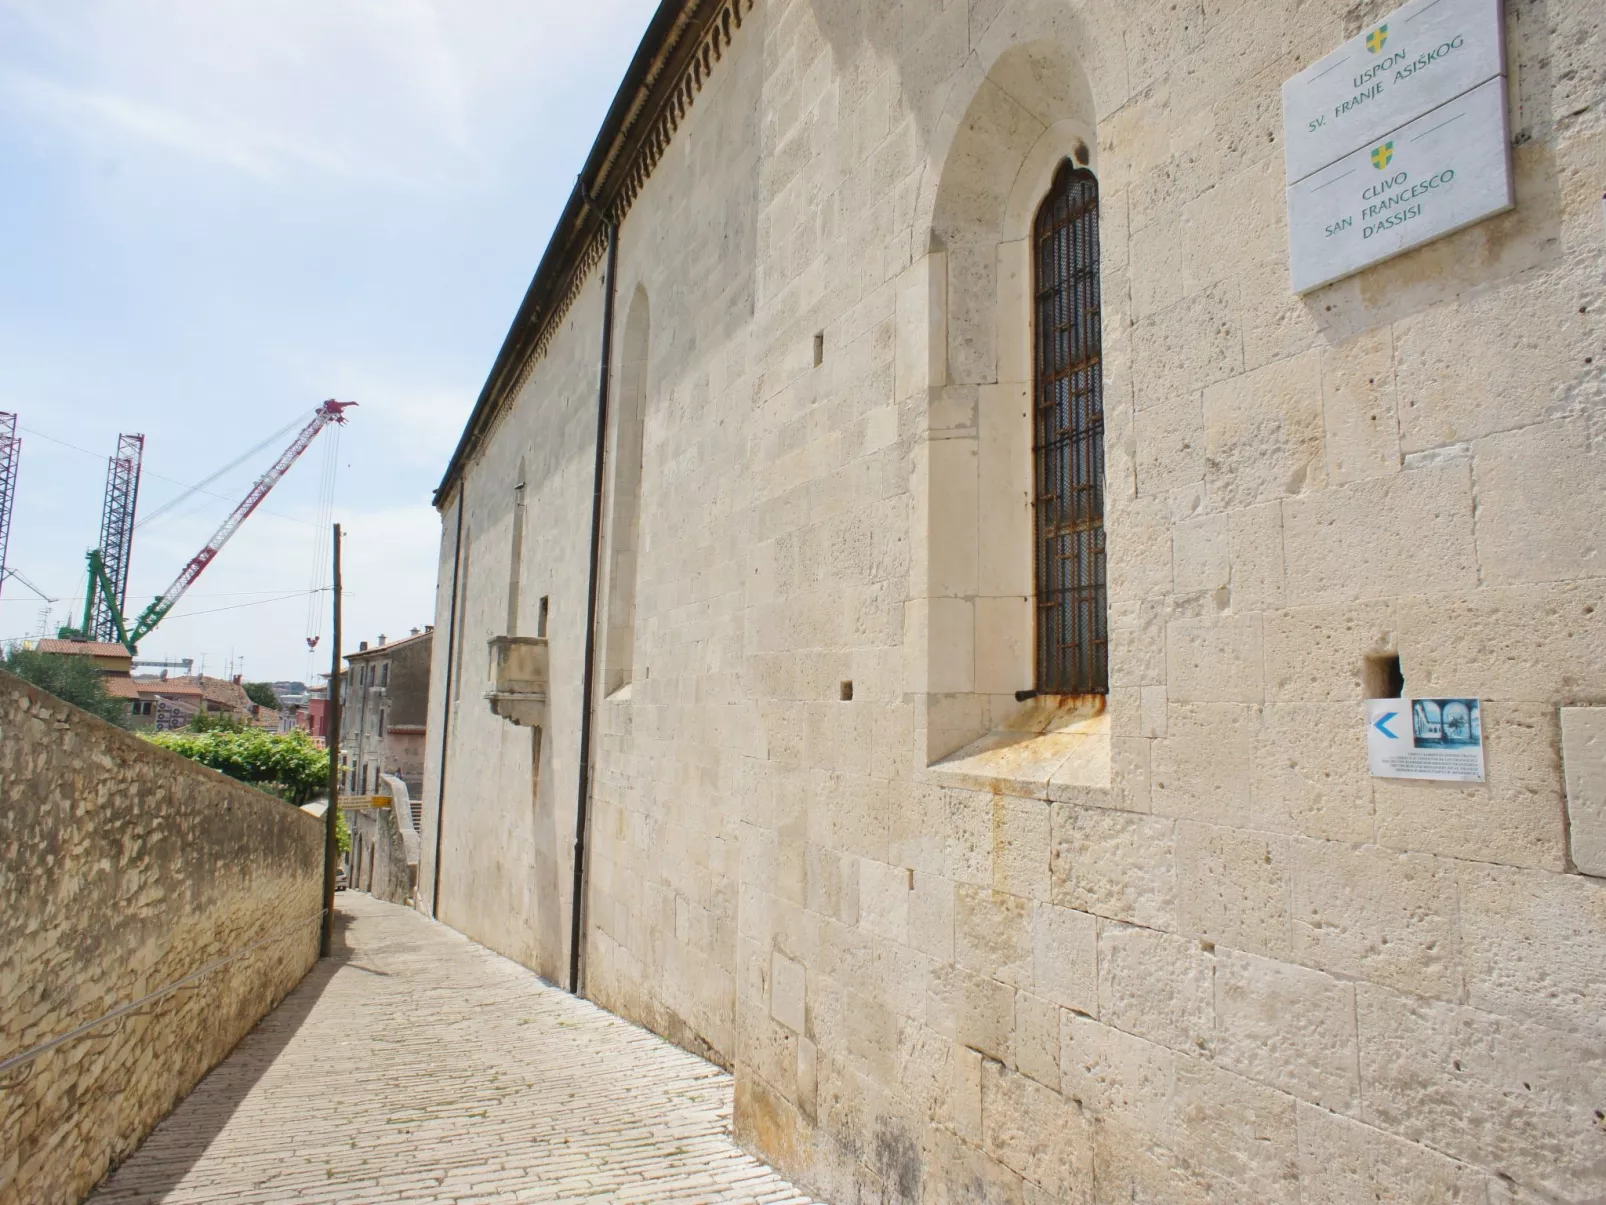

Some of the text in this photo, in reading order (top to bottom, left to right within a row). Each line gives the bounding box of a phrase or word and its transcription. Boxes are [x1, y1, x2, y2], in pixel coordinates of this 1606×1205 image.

[1308, 34, 1464, 133] SV. FRANJE ASIŠKOG
[1353, 48, 1406, 88] USPON
[1324, 169, 1455, 238] SAN FRANCESCO
[1362, 171, 1407, 201] CLIVO
[1363, 204, 1421, 239] D'ASSISI
